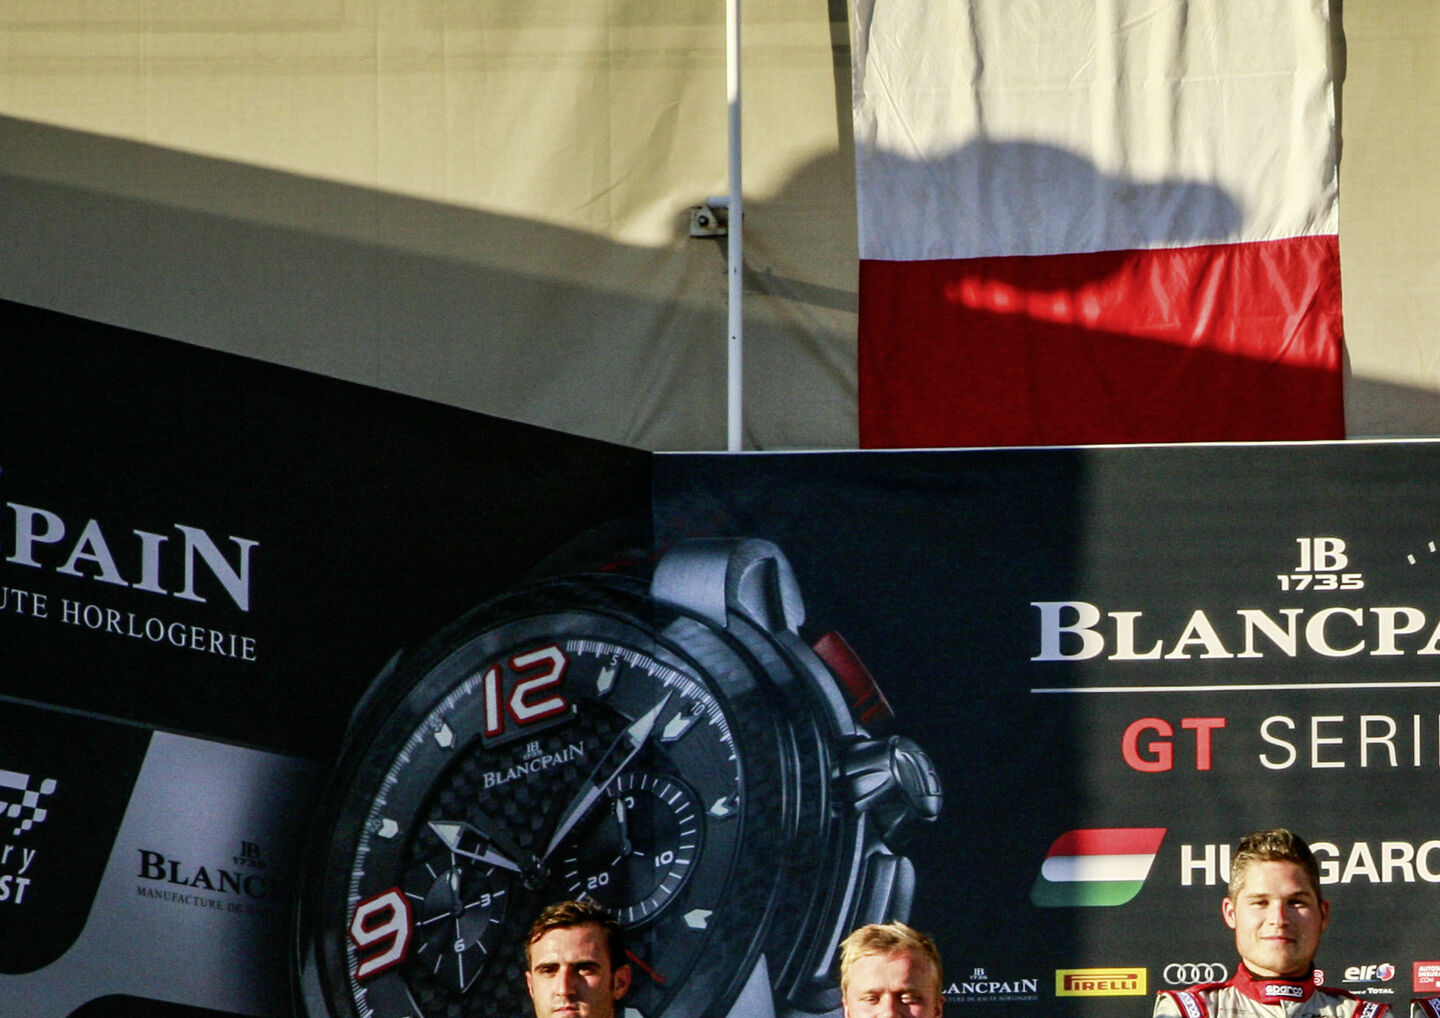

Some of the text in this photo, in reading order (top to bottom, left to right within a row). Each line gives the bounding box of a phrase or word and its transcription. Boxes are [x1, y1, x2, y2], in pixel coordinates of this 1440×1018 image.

[5, 501, 261, 613] PAIN
[1277, 574, 1365, 590] 1735
[61, 599, 258, 662] HORLOGERIE
[484, 644, 570, 736] 12
[1122, 718, 1227, 772] GT
[482, 741, 586, 789] BLANCPAIN
[138, 848, 269, 899] BLANC
[587, 871, 610, 890] 20
[1063, 973, 1138, 991] PIRELLI
[1344, 963, 1377, 981] elf
[1265, 985, 1303, 998] sparco
[1367, 987, 1394, 995] TOTAL
